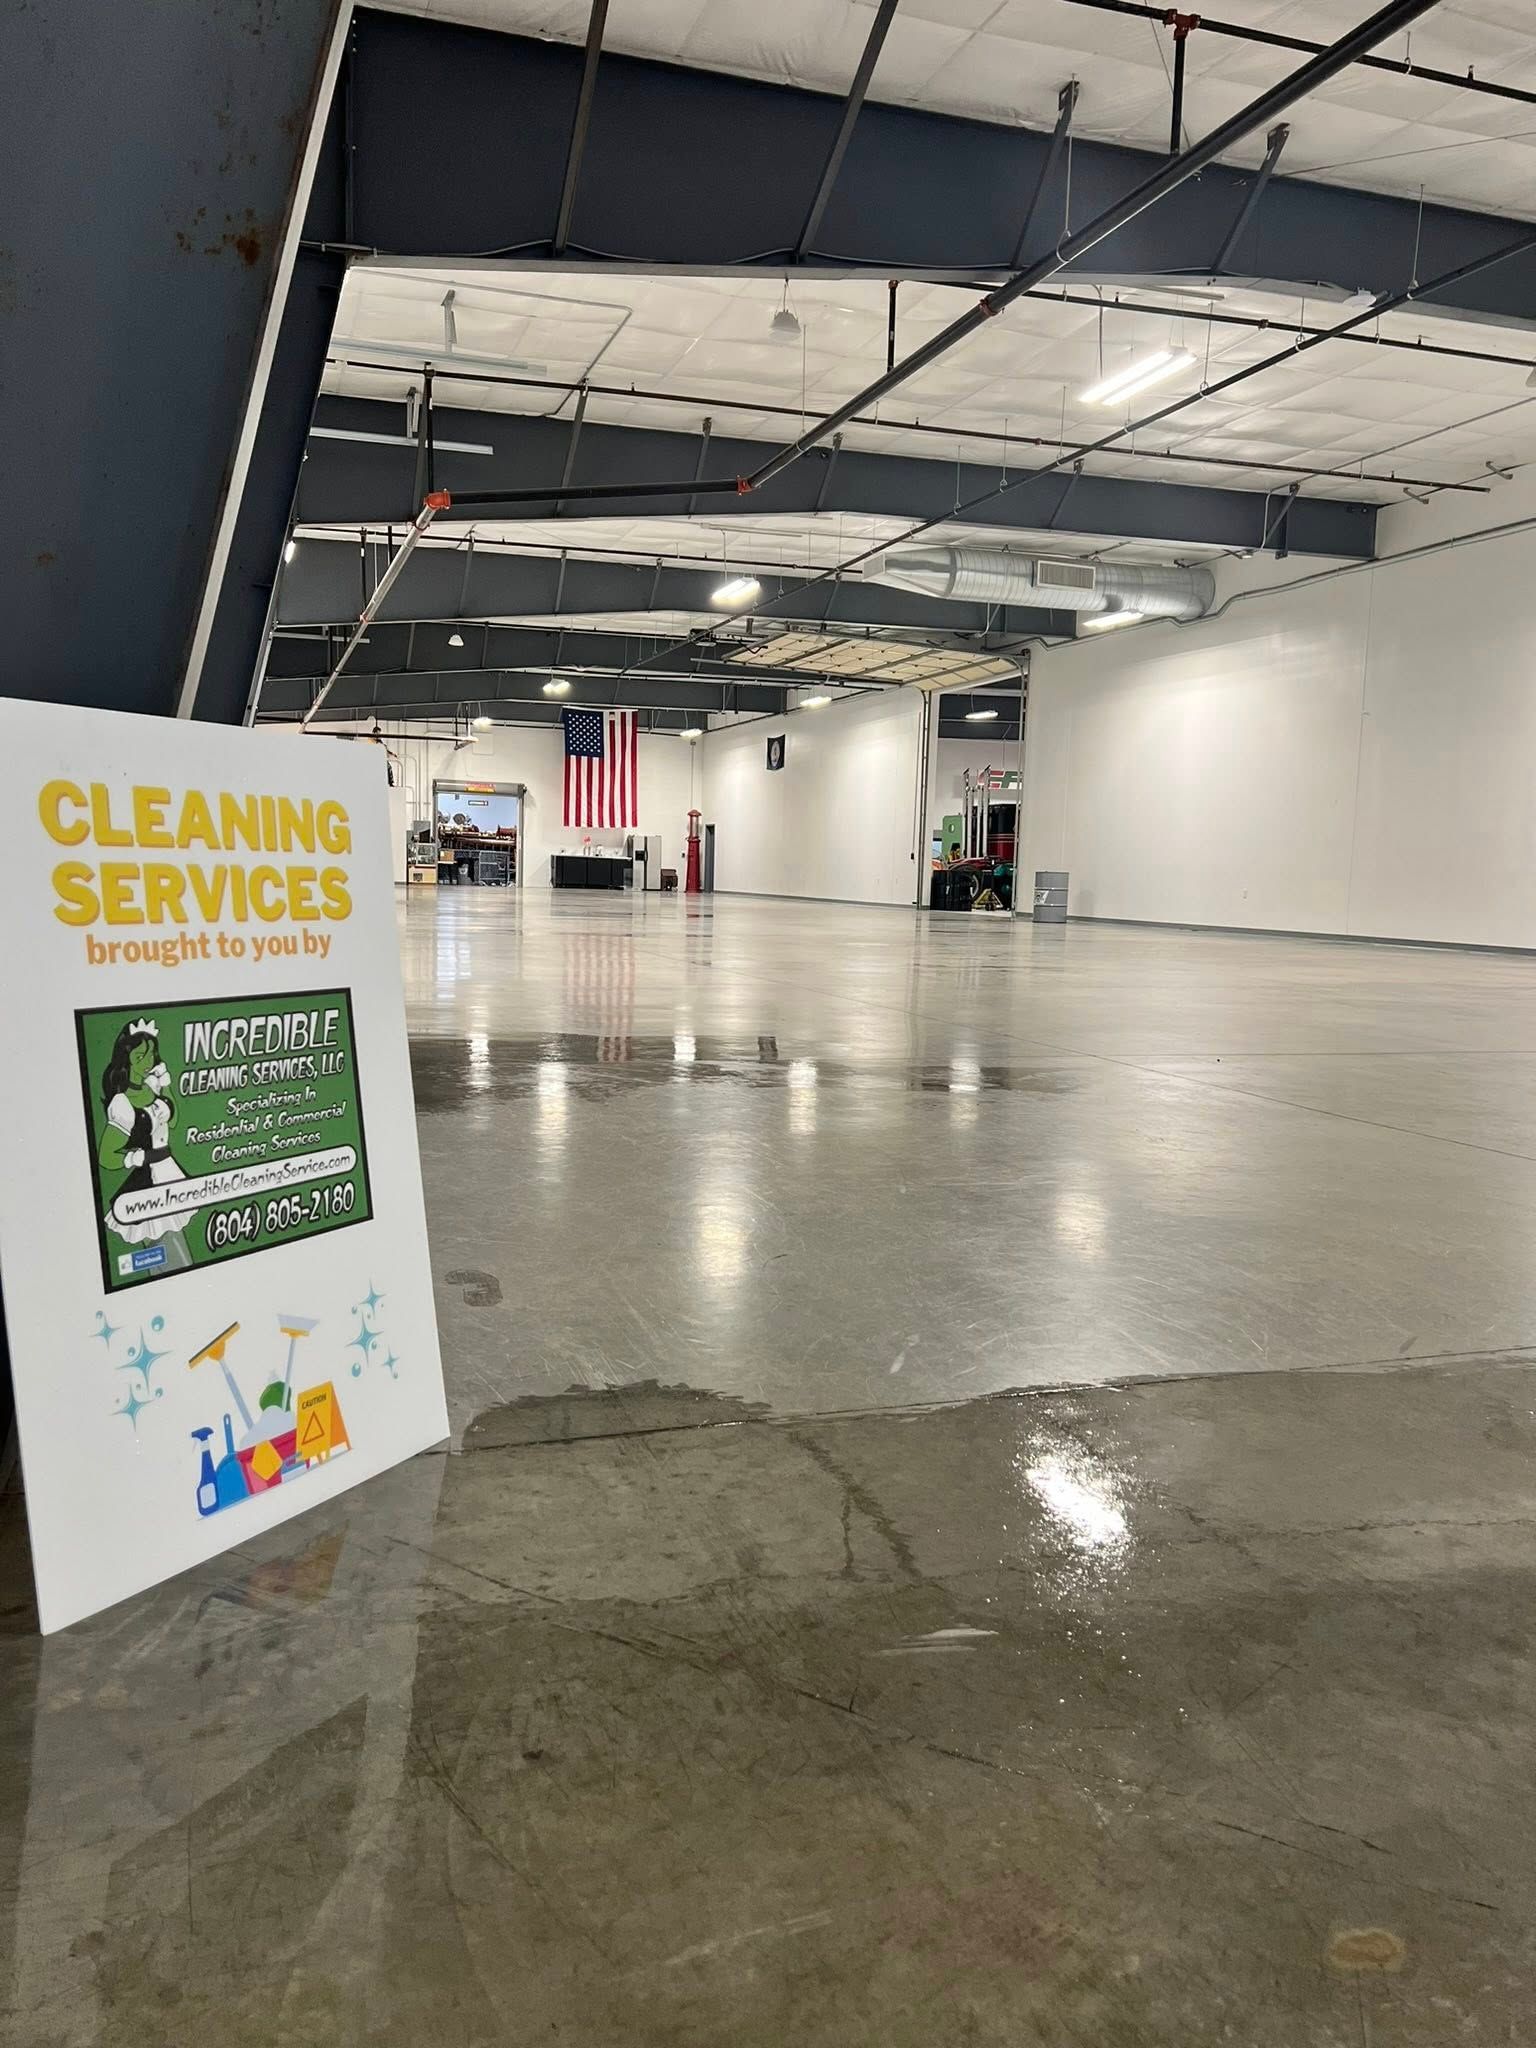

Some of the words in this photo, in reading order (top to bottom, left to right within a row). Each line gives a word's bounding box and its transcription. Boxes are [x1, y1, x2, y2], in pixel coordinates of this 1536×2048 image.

[38, 778, 352, 855] CLEANING
[51, 860, 353, 926] SERVICES
[86, 931, 211, 967] brought
[217, 931, 246, 958] to
[252, 934, 298, 962] you
[302, 927, 331, 958] by
[184, 1009, 339, 1063] INCREDIBLE
[179, 1063, 248, 1096] CLEANING
[252, 1055, 318, 1086] SERVICES,
[321, 1051, 345, 1075] LLC
[186, 1117, 260, 1145] Residential
[263, 1114, 273, 1130] &
[278, 1101, 347, 1127] Commercial
[226, 1091, 302, 1116] Specializing
[304, 1086, 317, 1099] In
[212, 1141, 267, 1163] Cleaning
[271, 1131, 321, 1151] Services
[125, 1155, 351, 1216] www.IncredibleCleaningService.com
[206, 1204, 261, 1250] (804)
[266, 1182, 354, 1232] 805-2180
[301, 1392, 327, 1410] CAUTION
